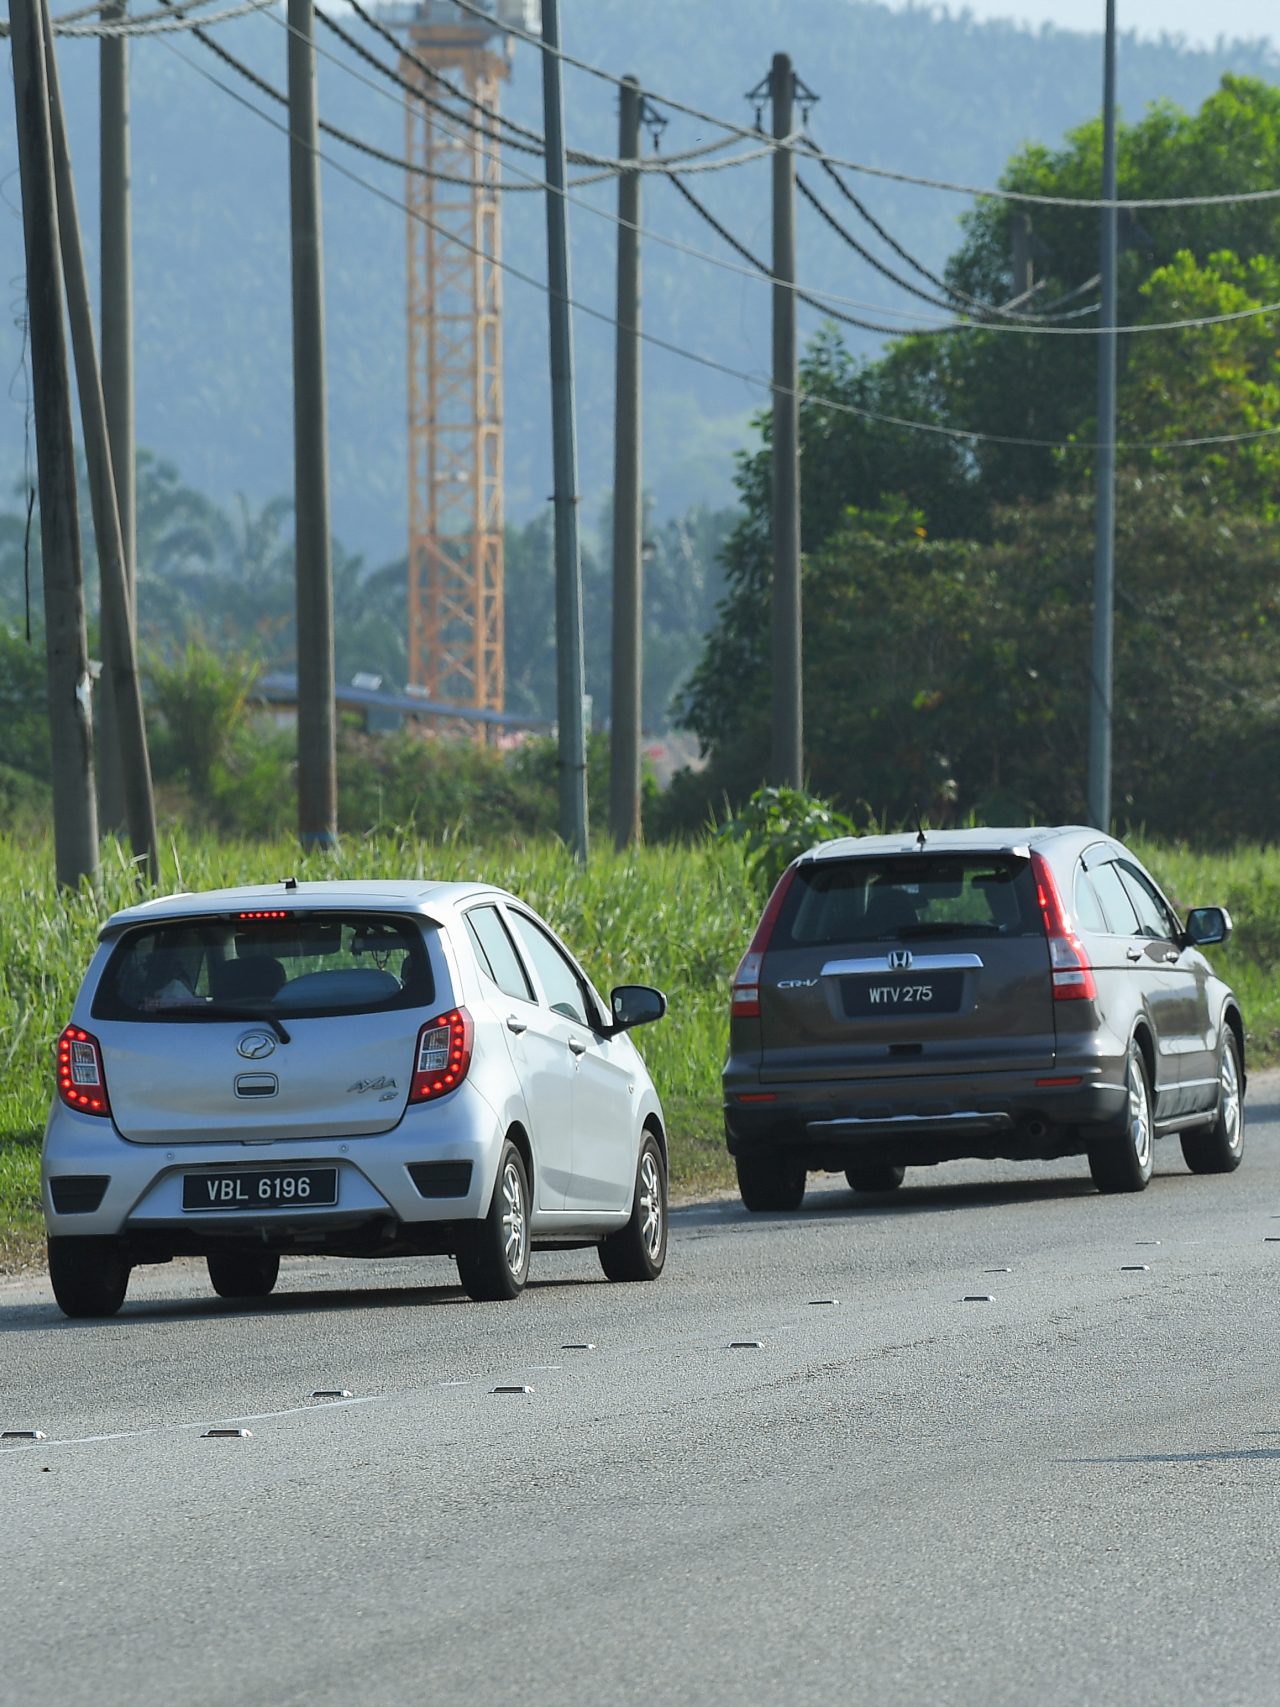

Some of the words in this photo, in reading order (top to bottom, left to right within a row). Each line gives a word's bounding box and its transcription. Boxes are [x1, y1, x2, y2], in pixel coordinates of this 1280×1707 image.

[869, 987, 900, 1004] WTV
[902, 985, 933, 1002] 275
[207, 1179, 249, 1201] VBL
[258, 1177, 311, 1199] 6196
